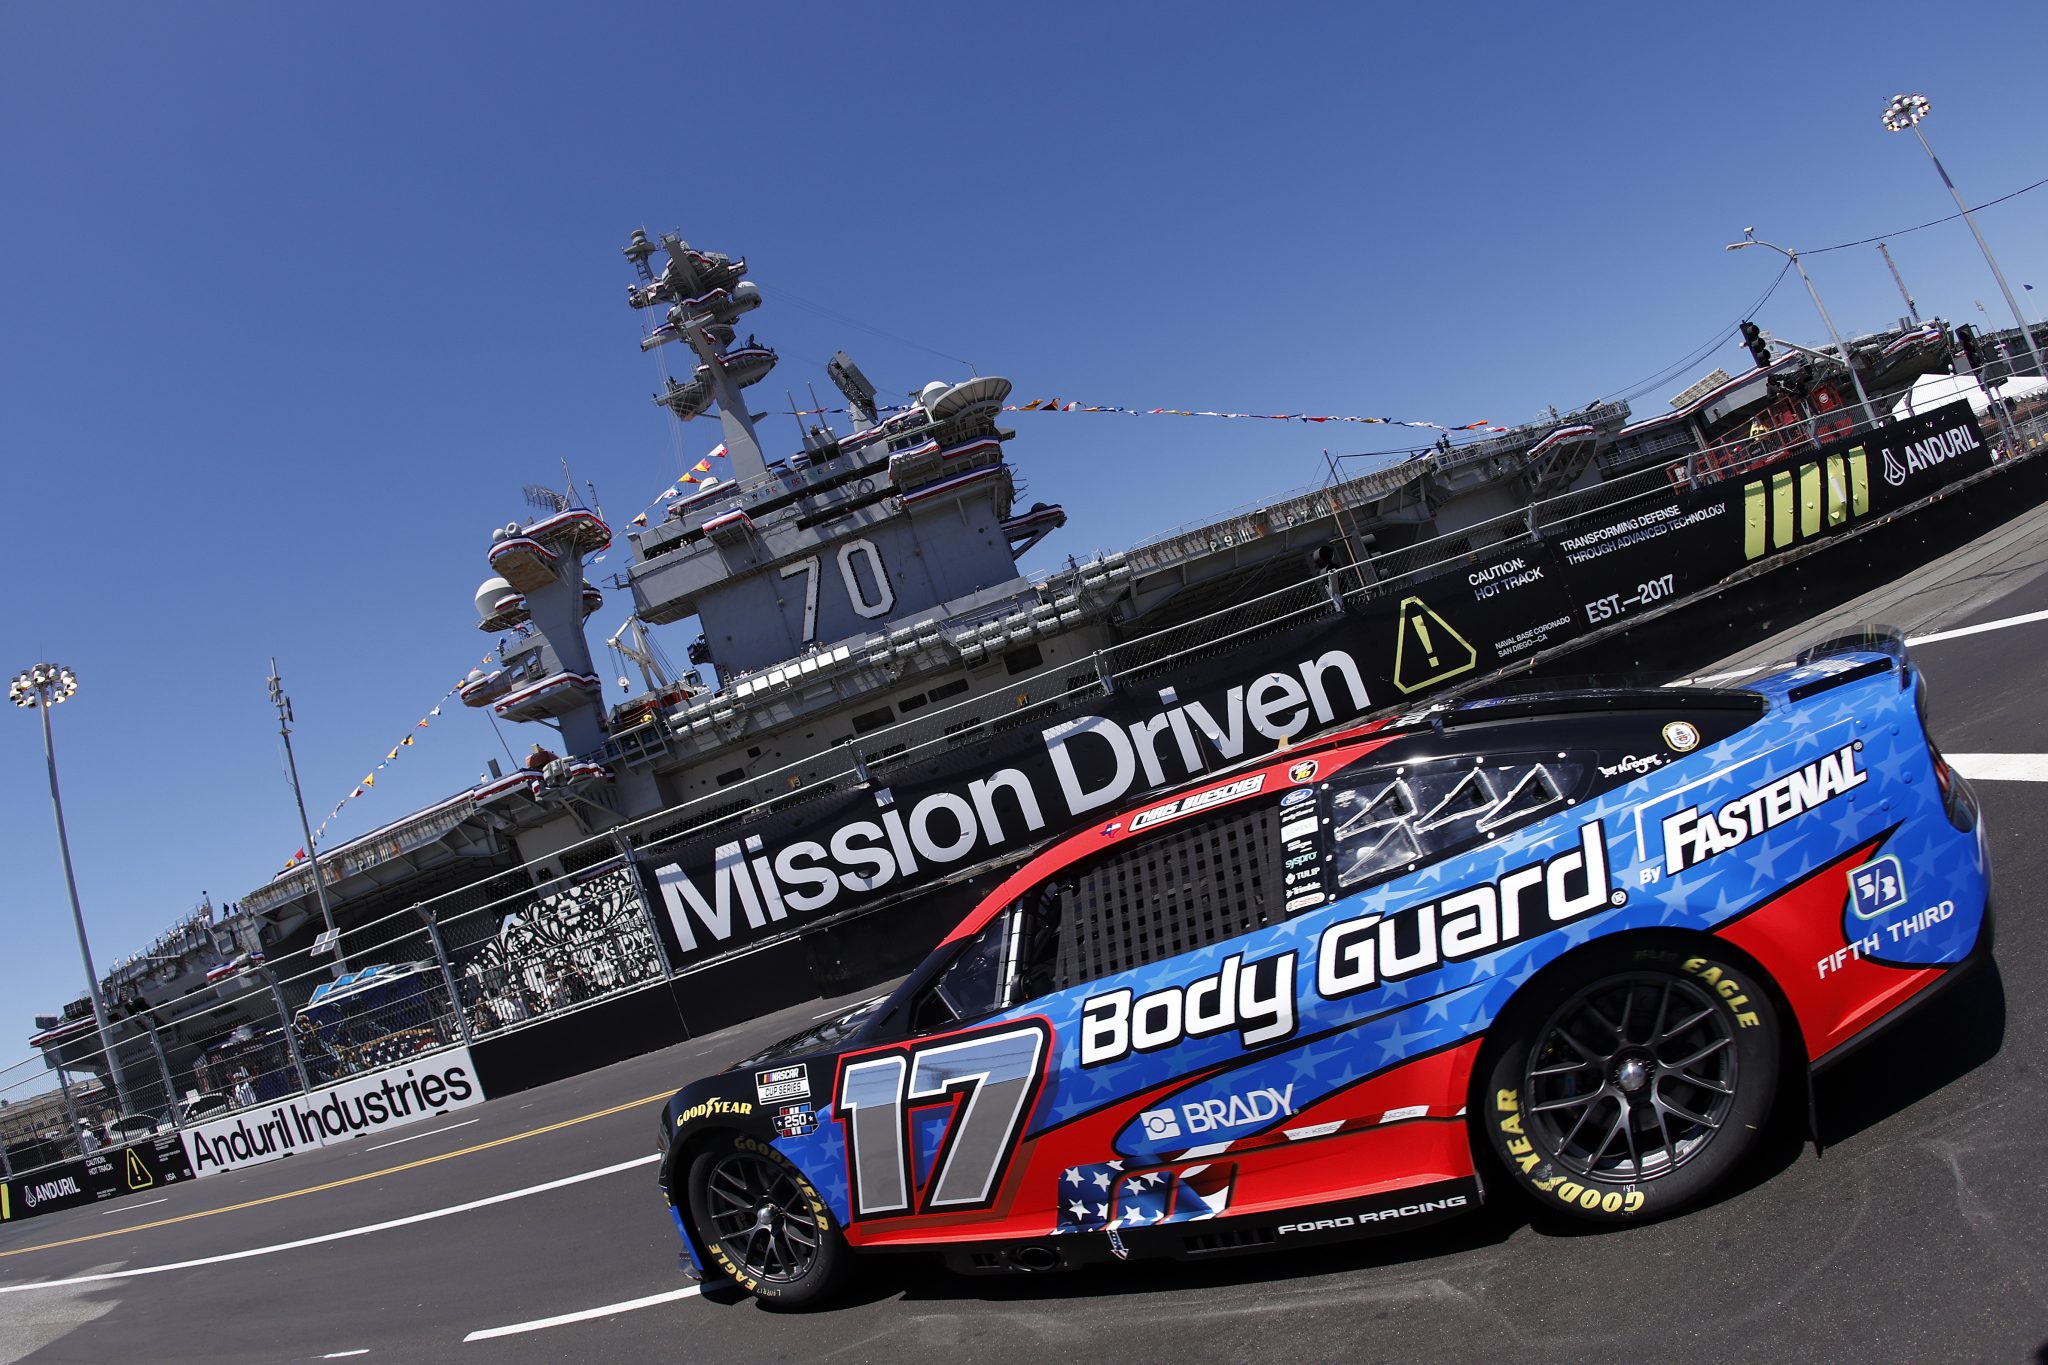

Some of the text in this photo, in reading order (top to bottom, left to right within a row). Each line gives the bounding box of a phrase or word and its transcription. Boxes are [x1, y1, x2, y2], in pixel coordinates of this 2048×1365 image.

[1905, 424, 1980, 474] ANDURIL
[1560, 504, 1681, 552] TRANSFORMING DEFENSE
[1566, 502, 1726, 567] THROUGH ADVANCED TECHNOLOGY
[780, 539, 896, 642] 70
[1468, 557, 1526, 587] CAUTION:
[1474, 566, 1545, 601] HOT TRACK
[1495, 615, 1571, 650] NAVAL BASE CORONADO
[1498, 646, 1512, 658] SAN
[1618, 754, 1659, 774] Kroger
[656, 650, 1371, 952] Mission Driven
[1129, 800, 1180, 832] CHRIS
[1180, 773, 1266, 812] BUESCHER
[1285, 851, 1318, 870] syspro
[1296, 866, 1321, 880] TULIP
[1639, 865, 1661, 885] By
[1081, 818, 1613, 1069] Body Guard
[1816, 900, 1955, 980] FIFTH THIRD
[1681, 958, 1761, 1029] EAGLE
[765, 1082, 802, 1097] CUP SERIES
[771, 1067, 799, 1081] NASCAR
[192, 1066, 472, 1171] Anduril Industries
[676, 1097, 752, 1127] GOODYEAR
[784, 1112, 807, 1129] 250
[840, 1025, 1044, 1215] 17
[1182, 1083, 1294, 1135] BRADY
[1497, 1088, 1645, 1213] GOODYEAR
[35, 1176, 81, 1202] ANDURIL
[164, 1172, 177, 1182] USA
[1278, 1195, 1468, 1235] FORD RACING
[708, 1243, 758, 1291] EAGLE
